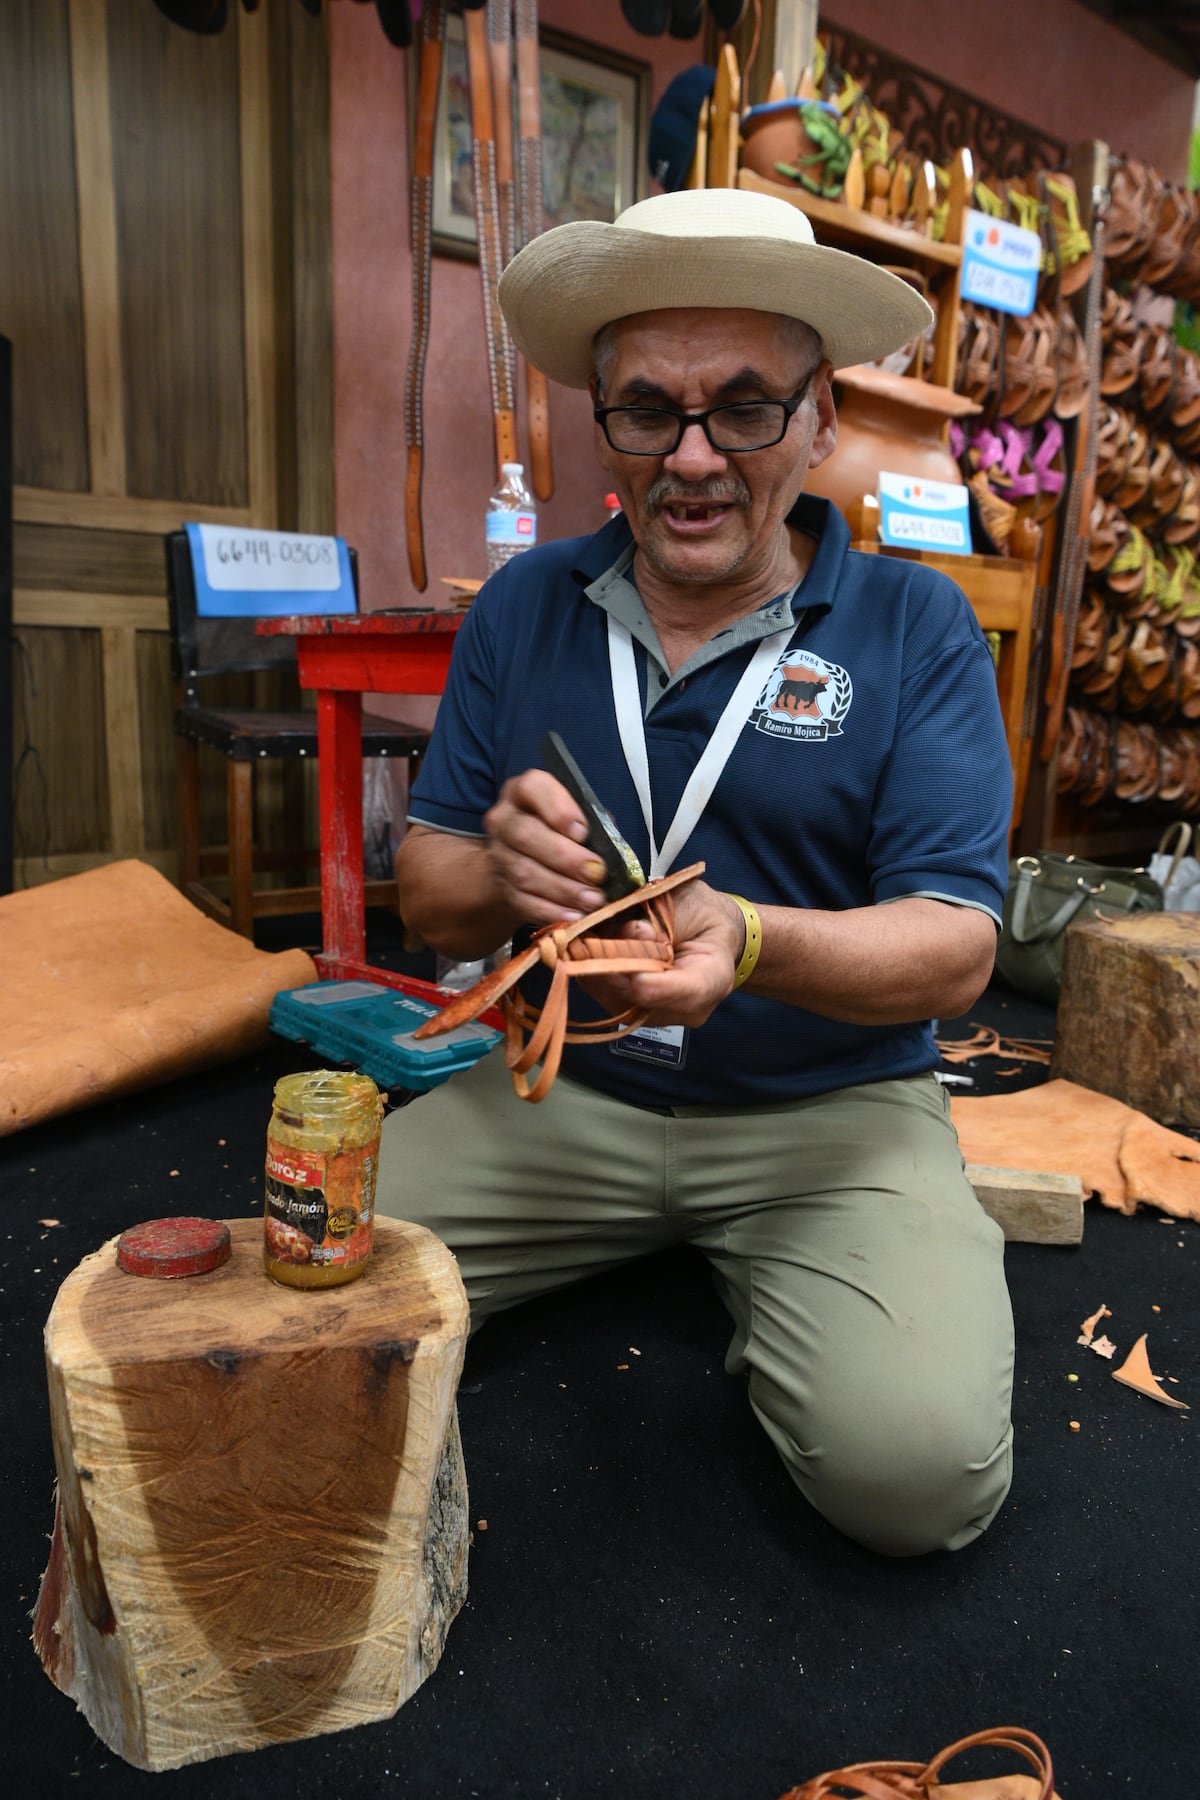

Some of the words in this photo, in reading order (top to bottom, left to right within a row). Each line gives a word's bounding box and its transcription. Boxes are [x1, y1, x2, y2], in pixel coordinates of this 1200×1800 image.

[800, 653, 820, 667] 1984
[764, 719, 793, 734] Ramiro
[793, 725, 821, 738] Mojica
